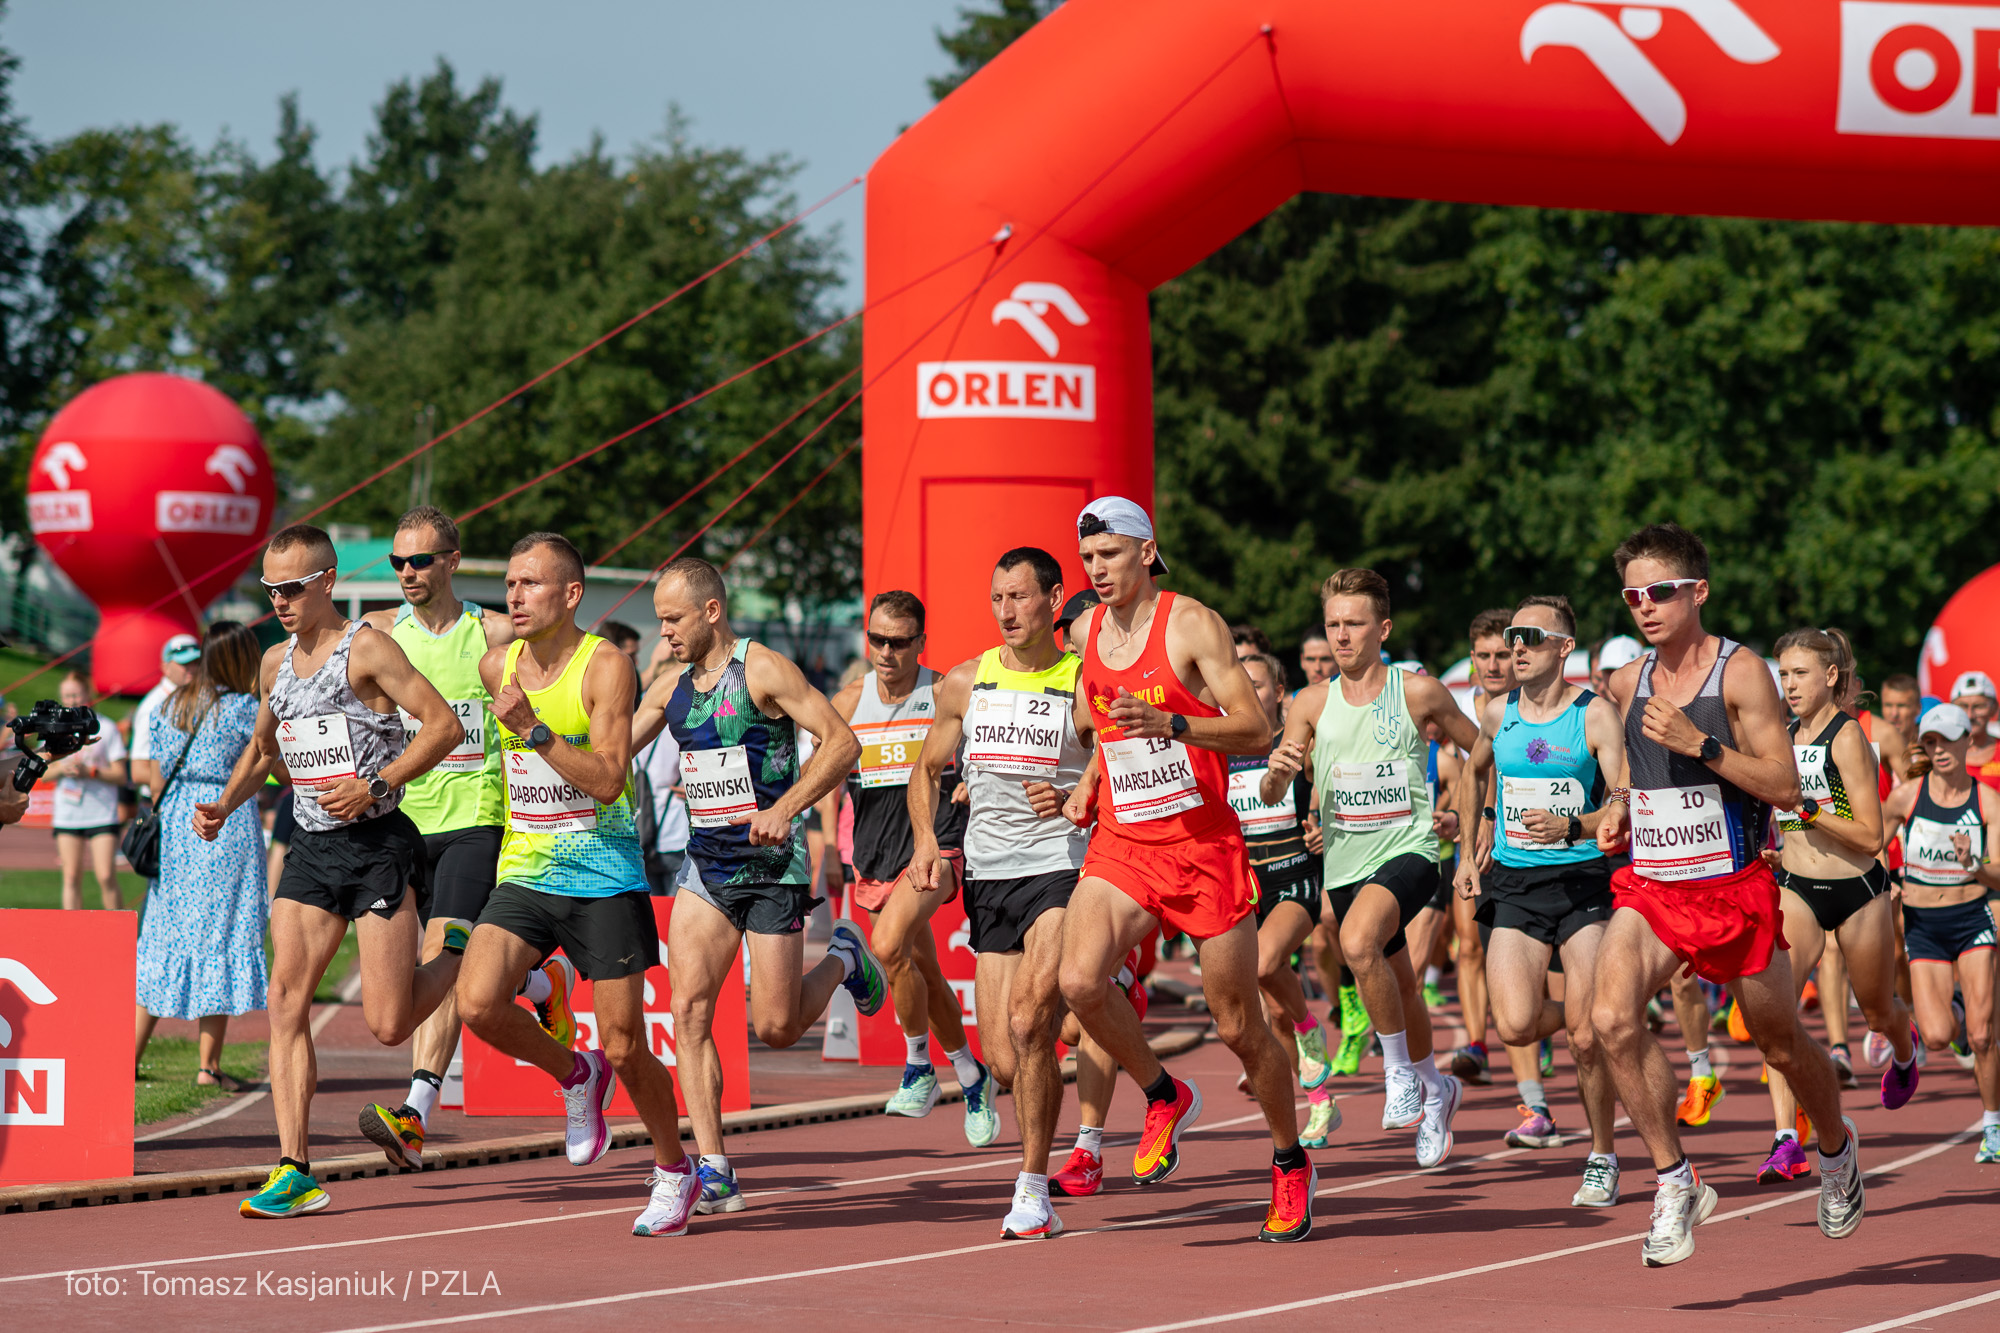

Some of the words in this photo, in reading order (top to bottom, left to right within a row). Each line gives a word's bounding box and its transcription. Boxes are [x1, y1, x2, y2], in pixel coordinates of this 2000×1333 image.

[929, 372, 1082, 410] ORLEN
[168, 501, 251, 525] ORLEN
[451, 703, 471, 717] 12
[1027, 699, 1051, 717] 22
[318, 720, 328, 735] 5
[974, 722, 1060, 748] STARŻYŃSKI
[285, 745, 351, 769] GŁOGOWSKI
[717, 752, 727, 767] 7
[880, 744, 907, 764] 58
[1800, 749, 1818, 763] 16
[1229, 761, 1259, 770] NIKE
[1375, 763, 1395, 778] 21
[1112, 759, 1191, 795] MARSZAŁEK
[685, 776, 751, 800] GOSIEWSKI
[1335, 786, 1407, 807] POŁCZYŃSKI
[1550, 781, 1571, 796] 24
[1680, 790, 1705, 810] 10
[1634, 820, 1723, 848] KOZŁOWSKI
[1267, 859, 1291, 873] NIKE
[1291, 853, 1308, 866] PRO
[1689, 866, 1706, 874] 2023
[4, 1069, 48, 1115] N
